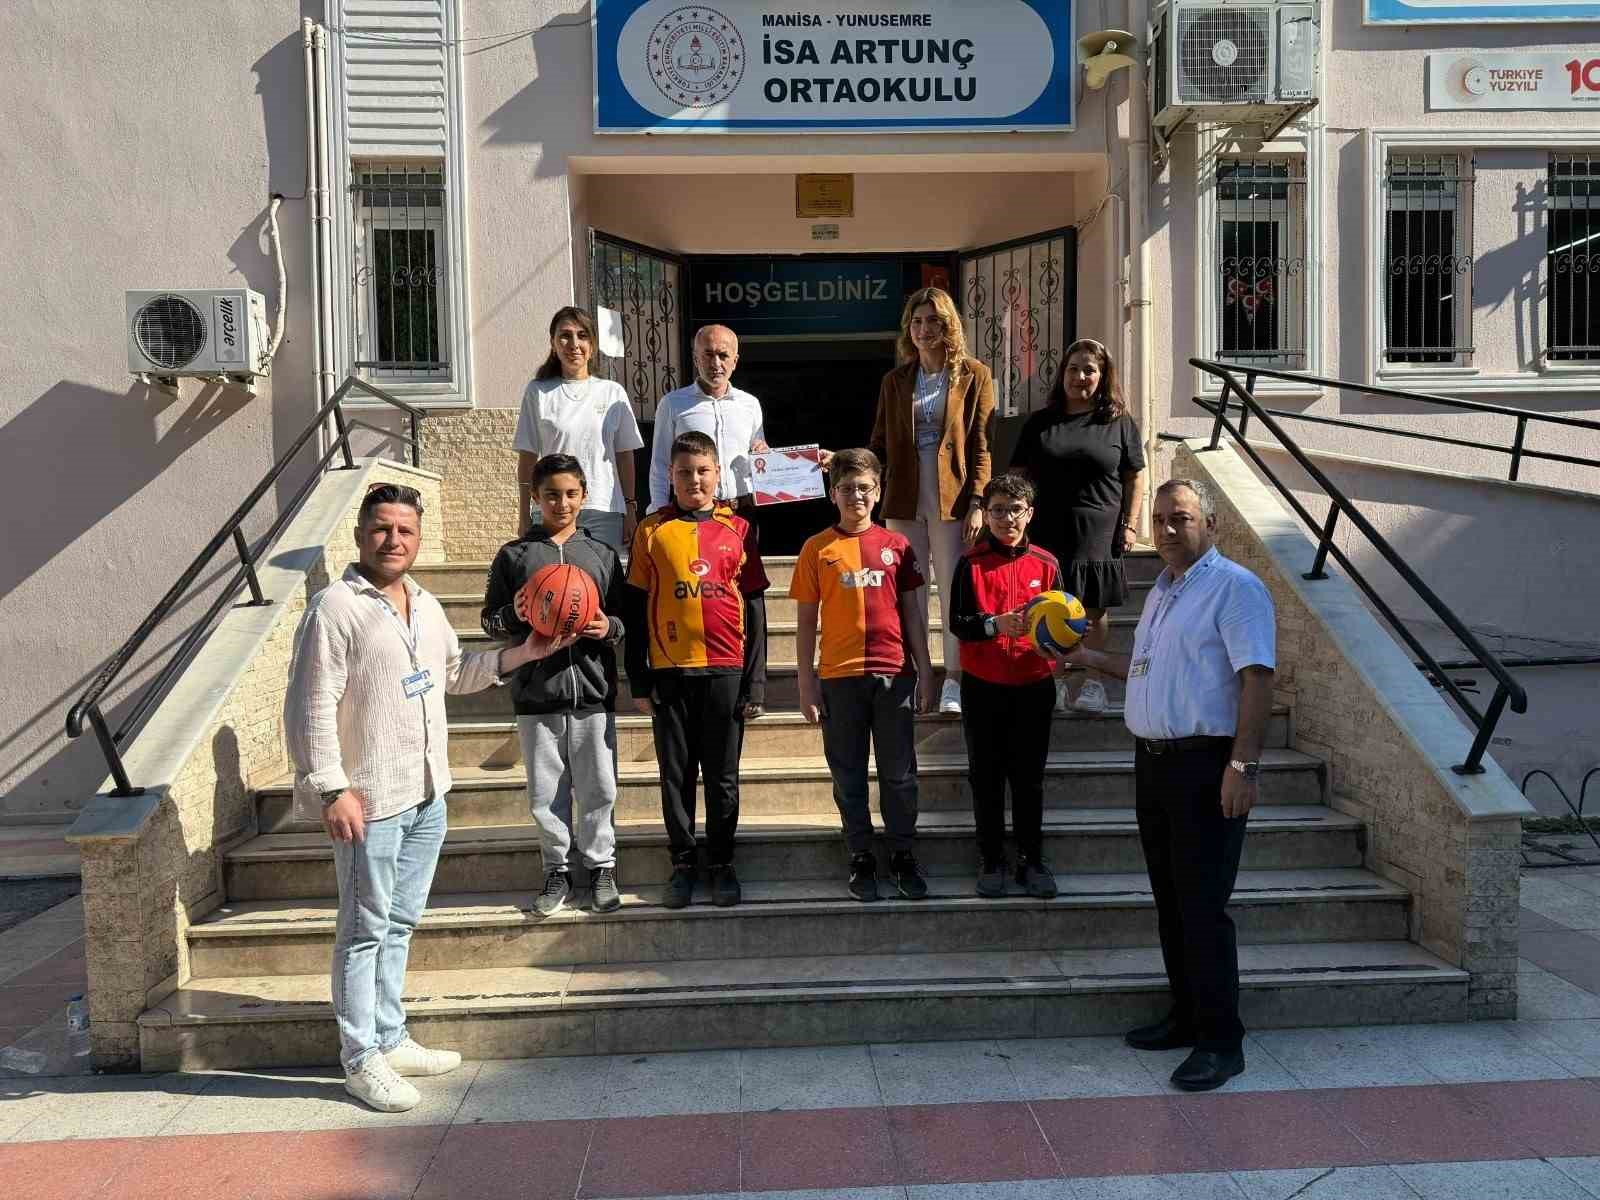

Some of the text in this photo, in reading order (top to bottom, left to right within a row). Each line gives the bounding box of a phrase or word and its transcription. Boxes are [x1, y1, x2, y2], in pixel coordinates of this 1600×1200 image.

[762, 12, 822, 26] MANİSA
[836, 14, 932, 26] YUNUSEMRE
[763, 34, 974, 70] İSA ARTUNÇ
[764, 77, 977, 103] ORTAOKULU
[705, 275, 888, 308] HOŞGELDİNİZ
[221, 297, 236, 347] arçelik
